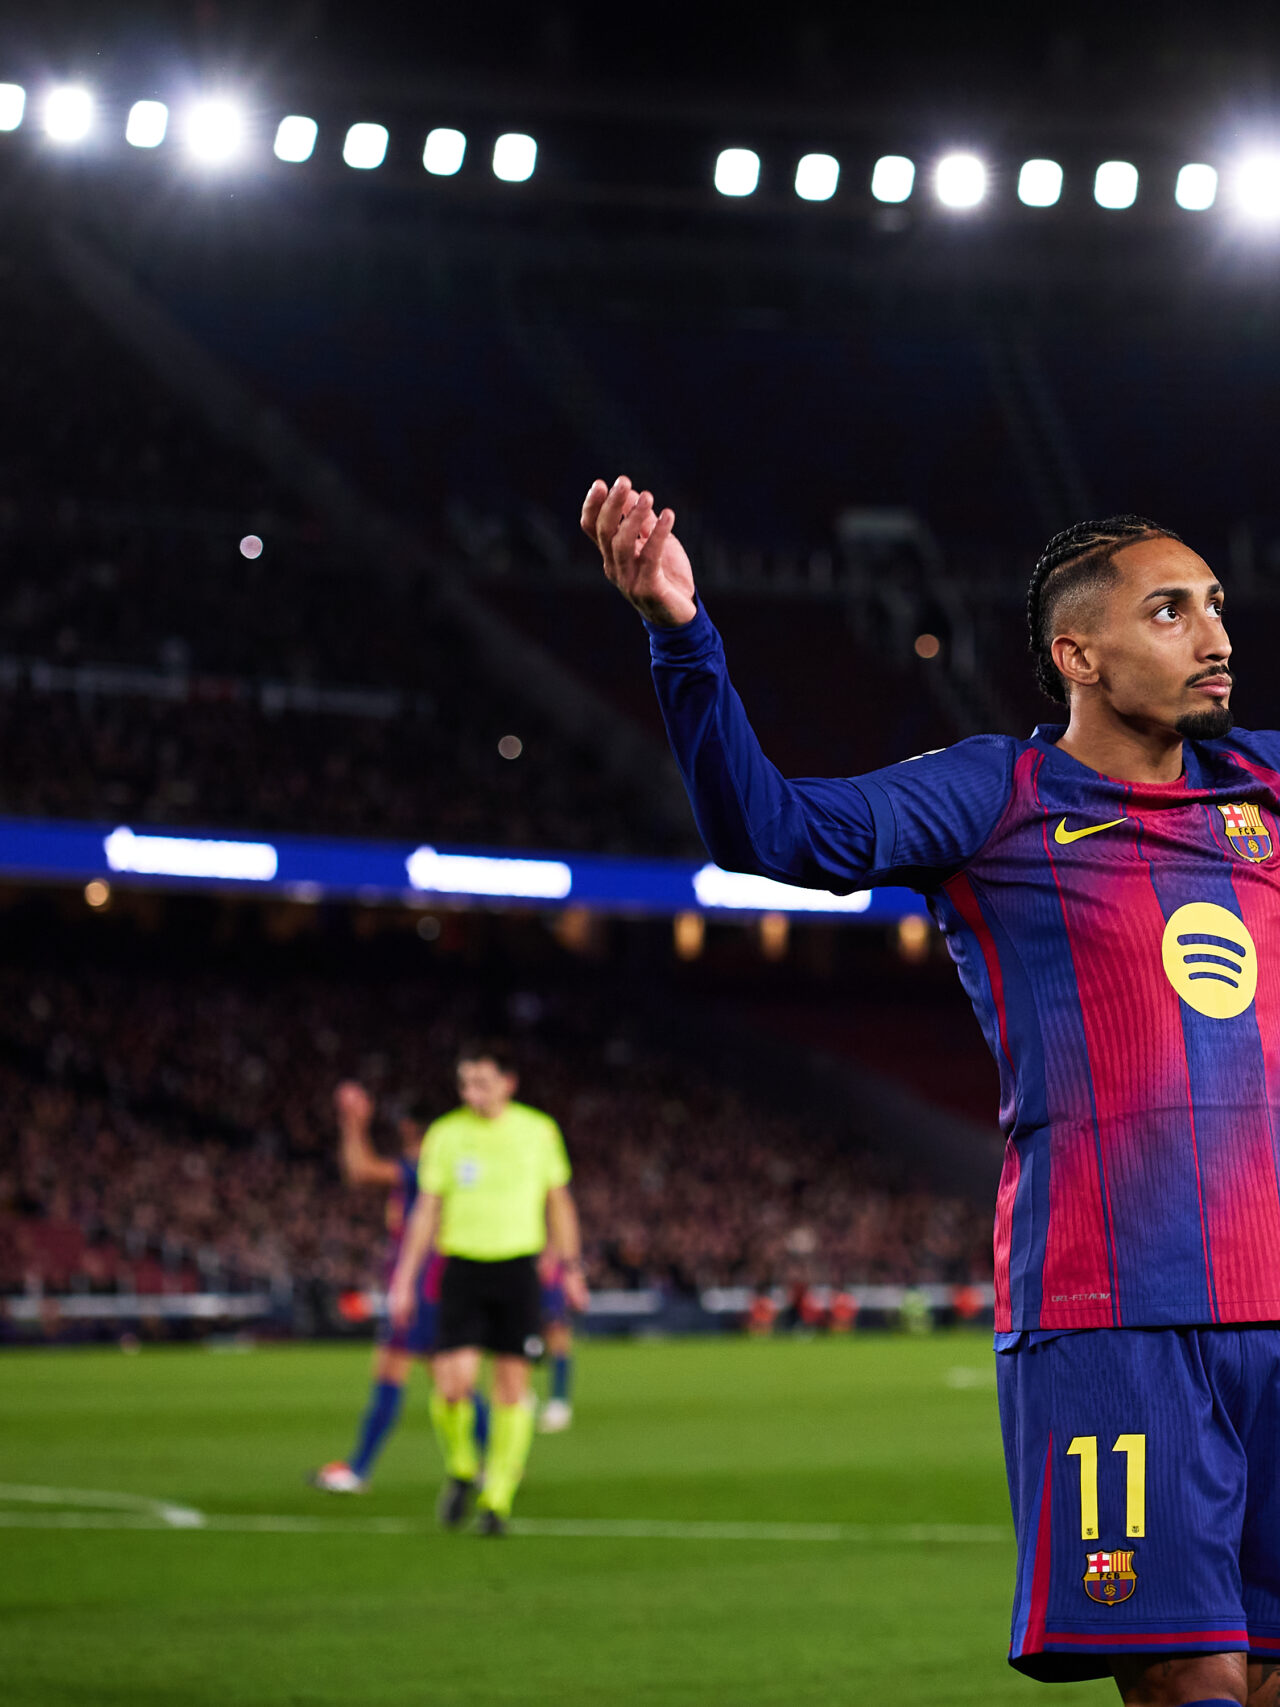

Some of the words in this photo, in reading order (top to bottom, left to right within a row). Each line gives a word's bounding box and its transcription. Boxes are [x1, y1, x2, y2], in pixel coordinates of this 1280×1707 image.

[1238, 827, 1257, 836] FCB
[1066, 1434, 1146, 1540] 11
[1099, 1572, 1120, 1580] FCB
